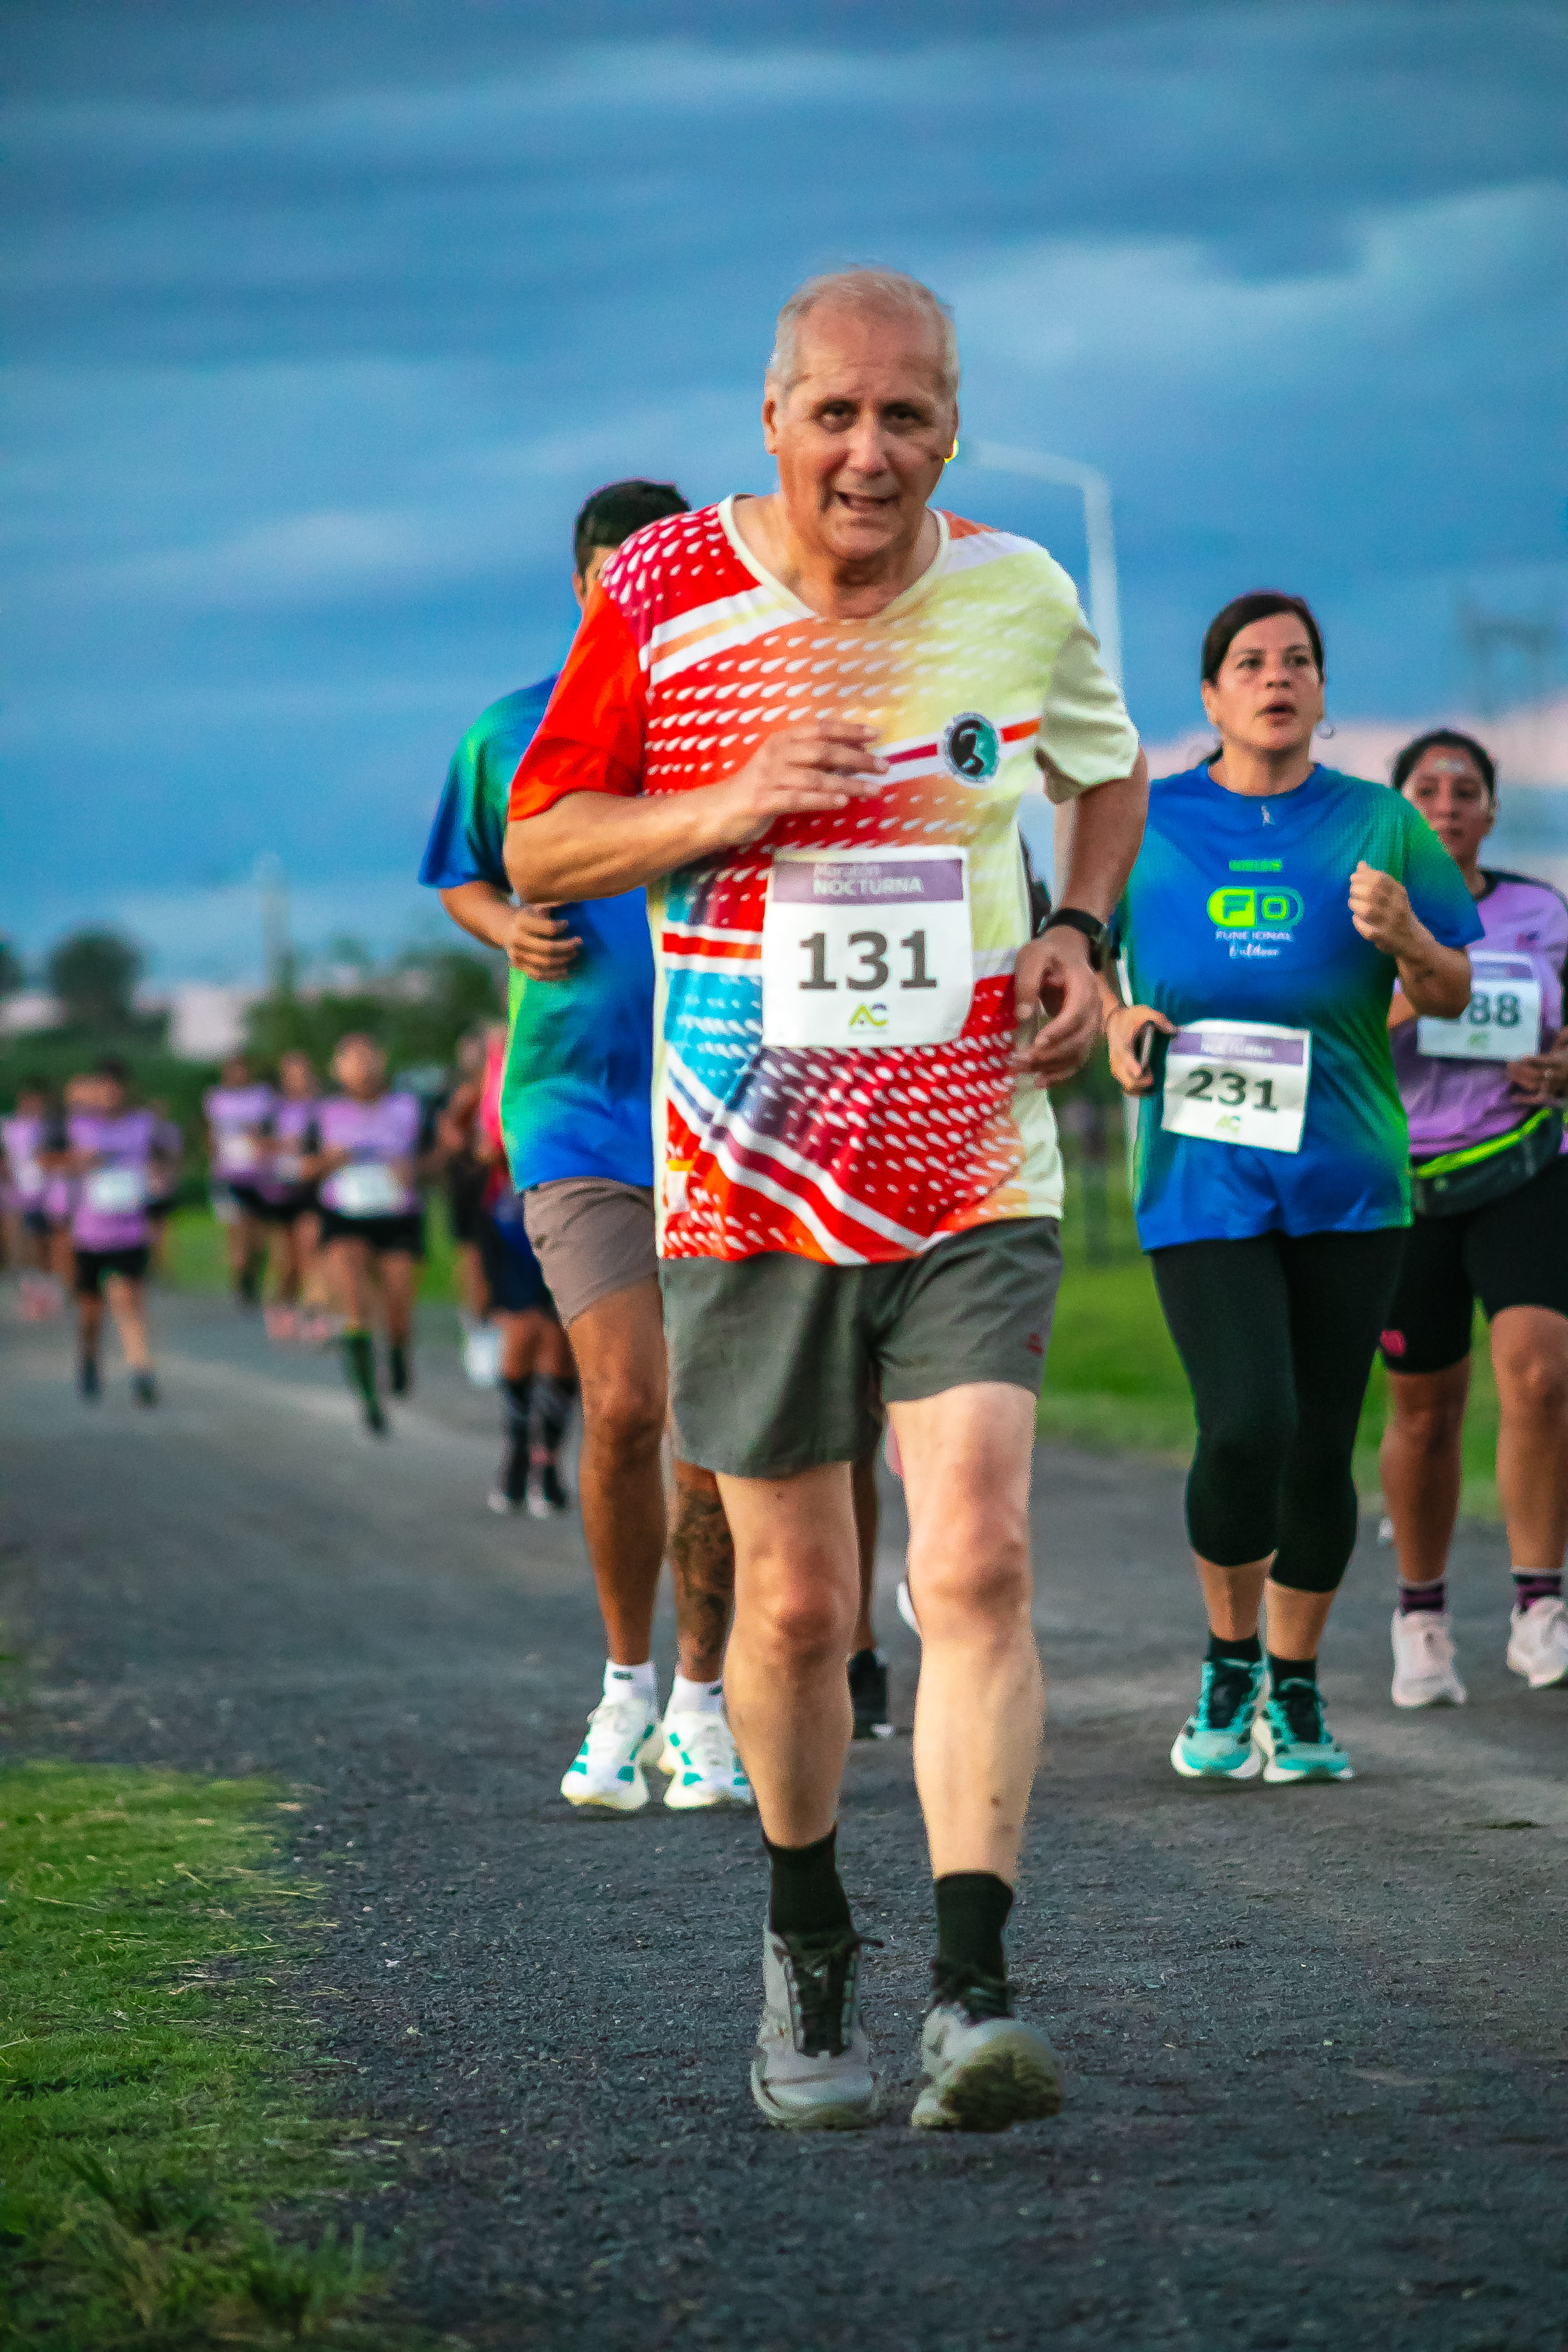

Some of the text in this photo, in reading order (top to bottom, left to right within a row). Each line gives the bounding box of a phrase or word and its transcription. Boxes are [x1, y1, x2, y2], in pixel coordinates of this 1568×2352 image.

[813, 876, 923, 895] NOCTURNA
[799, 929, 937, 991] 131
[1468, 993, 1521, 1027] 88
[1185, 1068, 1278, 1113] 231
